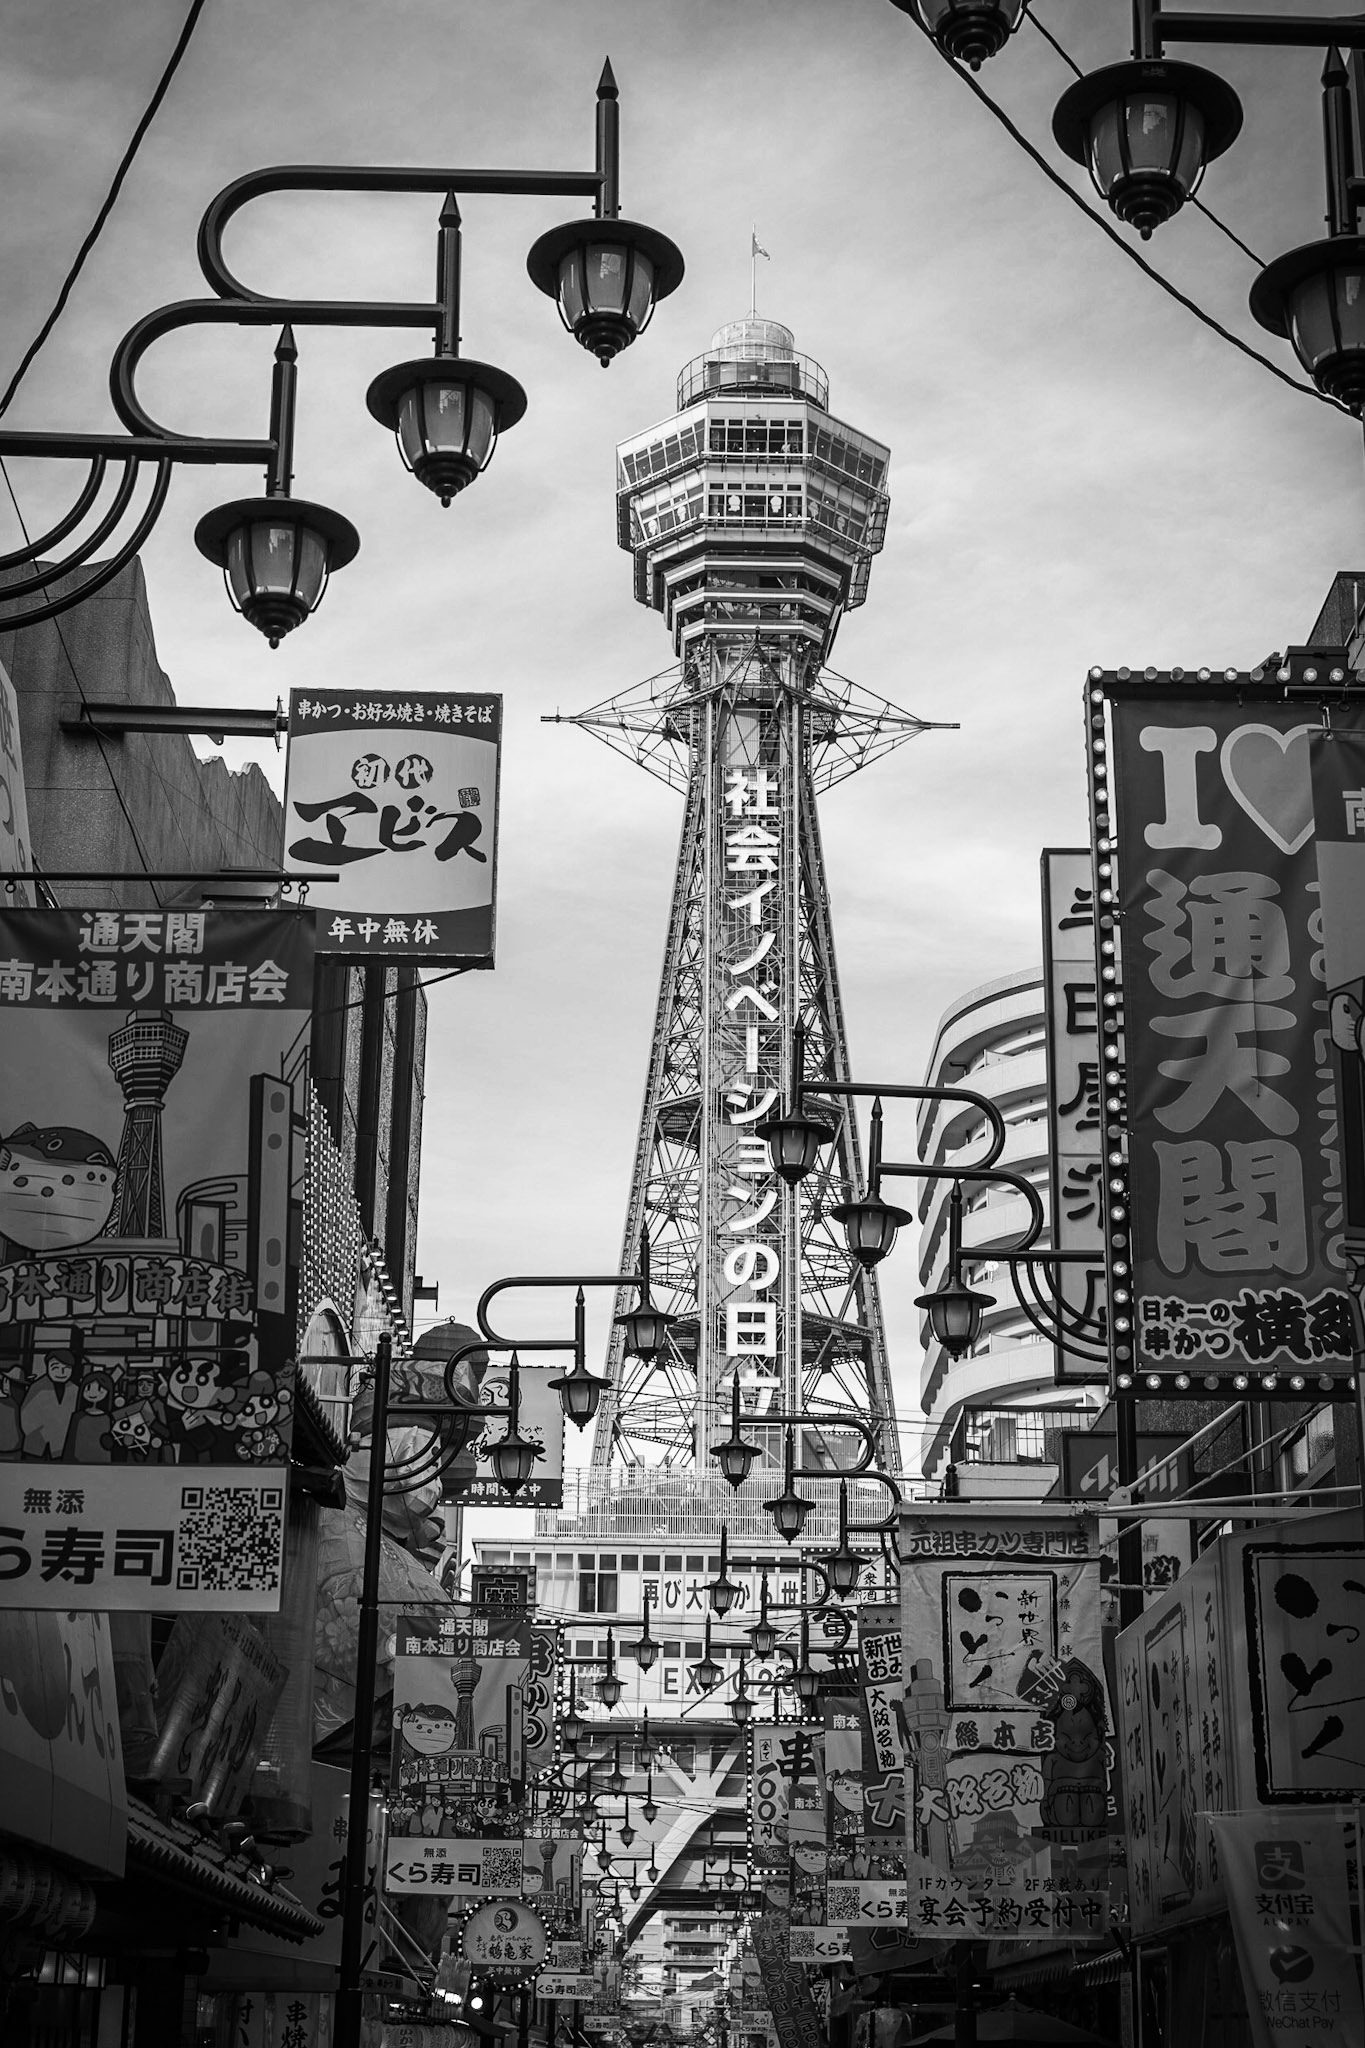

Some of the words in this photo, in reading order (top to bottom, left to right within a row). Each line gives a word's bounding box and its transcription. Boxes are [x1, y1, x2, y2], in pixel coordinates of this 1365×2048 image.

[298, 699, 494, 723] 串かつ・お好み焼き・焼きそば
[352, 754, 433, 789] 初代
[1139, 726, 1222, 850] I
[78, 911, 206, 954] 通天閣
[328, 916, 440, 945] 年中無休
[0, 958, 289, 1003] 南本通り商店会
[1143, 868, 1310, 1274] 通天閣
[0, 1262, 255, 1315] 本通り商店街
[1143, 1301, 1230, 1322] 日本一の
[1145, 1328, 1230, 1355] 串かつ
[1080, 1454, 1178, 1493] Ashi
[22, 1487, 86, 1514] 無添
[910, 1530, 1089, 1555] 元祖串カツ専門店
[438, 1618, 489, 1636] 通天閣
[1017, 1590, 1044, 1647] 新世界
[405, 1636, 521, 1657] 南本通り商店会
[956, 1720, 1055, 1749] 総本店
[917, 1763, 1045, 1826] 大阪名物
[388, 1862, 481, 1885] くら寿司
[917, 1897, 1101, 1927] 宴会予約受付中
[1255, 1893, 1315, 1915] 支付宝
[1313, 2016, 1335, 2031] Pay
